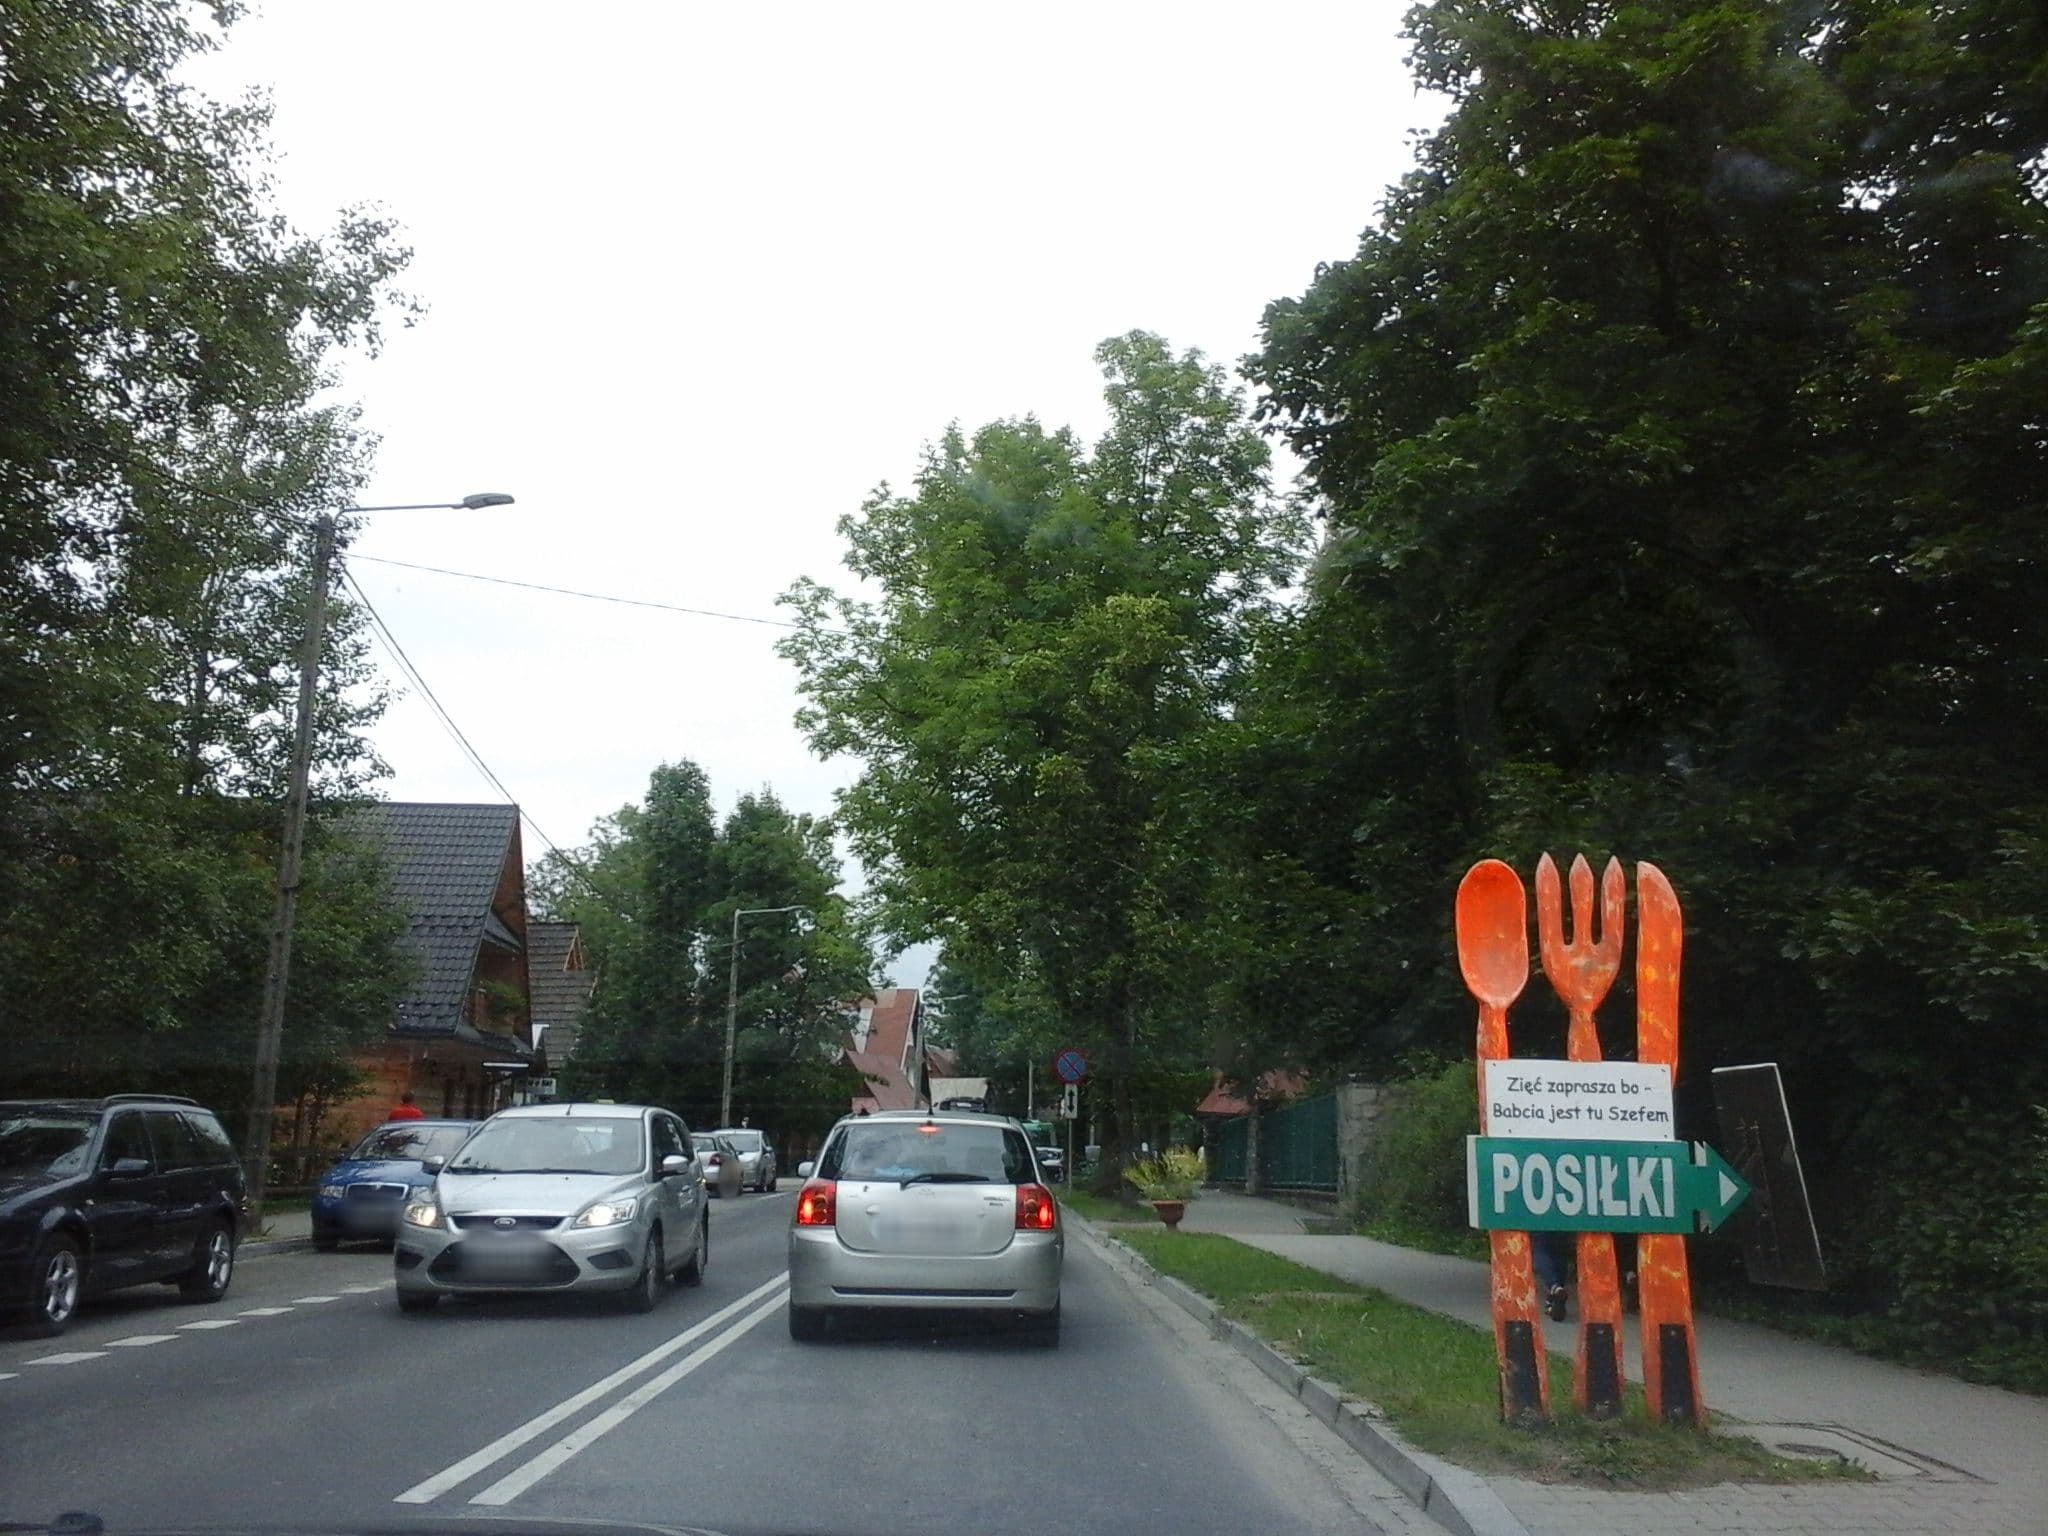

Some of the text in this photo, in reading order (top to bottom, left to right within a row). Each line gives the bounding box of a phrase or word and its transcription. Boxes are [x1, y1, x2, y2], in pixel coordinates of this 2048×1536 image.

[1507, 1076, 1543, 1095] Zięć
[1547, 1081, 1616, 1097] zaprasza
[1621, 1079, 1640, 1094] bo
[1493, 1103, 1669, 1124] Babcia jest tu Szefem
[1492, 1153, 1675, 1218] POSIŁKI
